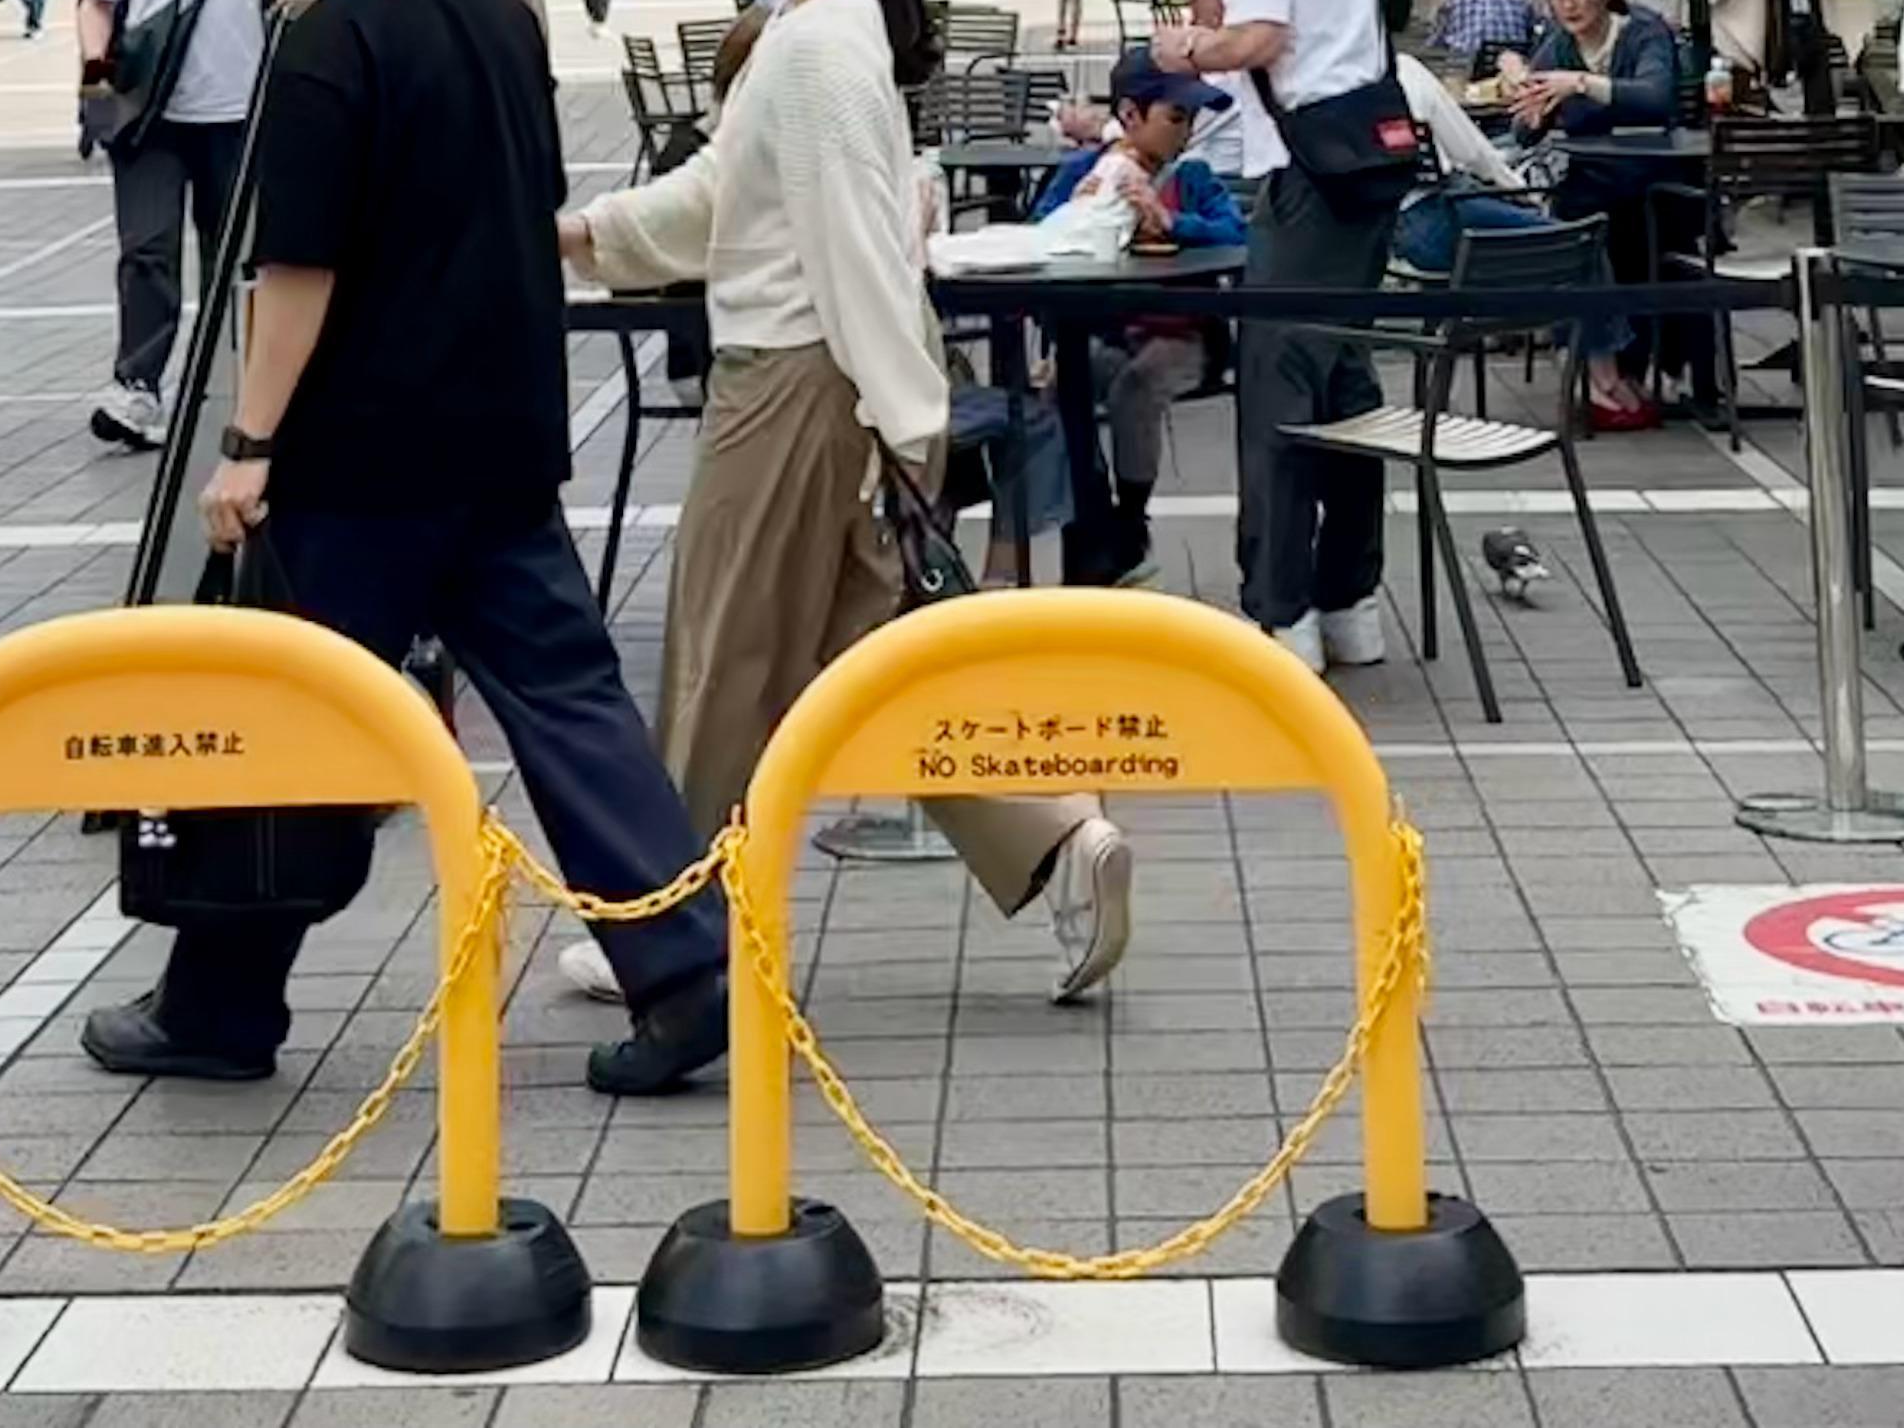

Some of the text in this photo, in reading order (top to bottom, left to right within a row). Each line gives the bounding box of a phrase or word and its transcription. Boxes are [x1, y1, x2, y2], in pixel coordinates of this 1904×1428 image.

[934, 713, 1169, 743] スケートボード禁止
[64, 730, 245, 761] 自転車進入禁止
[919, 752, 1179, 779] NO Skateboarding
